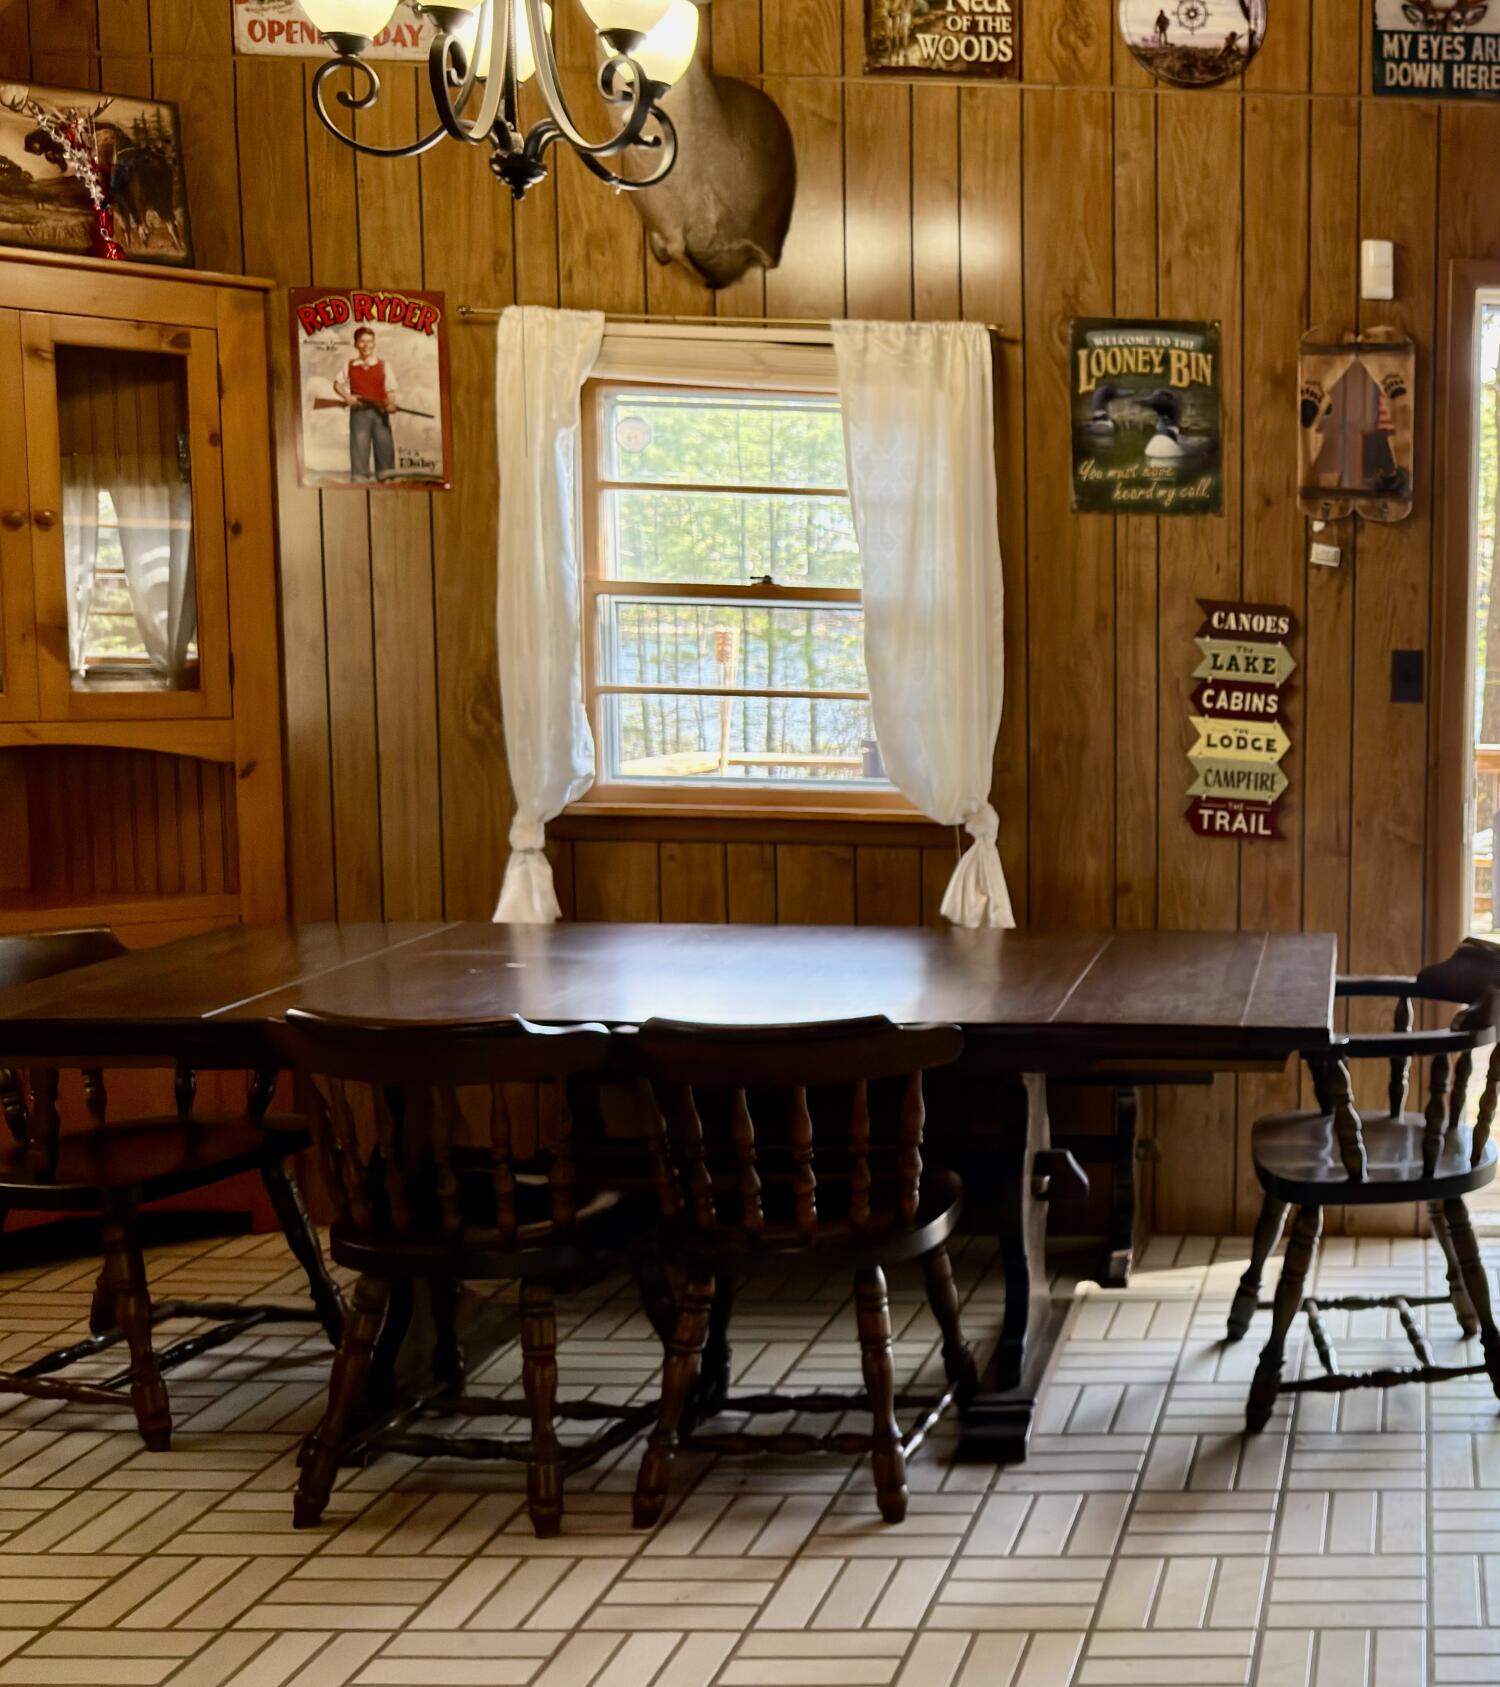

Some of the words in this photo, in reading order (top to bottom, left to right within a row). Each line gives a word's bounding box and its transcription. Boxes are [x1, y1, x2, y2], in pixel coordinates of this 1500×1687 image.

[247, 18, 325, 45] OPEN
[946, 15, 971, 32] OF
[974, 15, 1012, 33] THE
[916, 33, 1013, 62] WOODS
[1383, 33, 1412, 59] MY
[1417, 34, 1466, 61] EYES
[1385, 61, 1444, 88] DOWN
[297, 298, 350, 336] RED
[352, 292, 438, 336] RYDER
[1078, 346, 1165, 395] LOONEY
[1168, 348, 1213, 388] BIN
[1212, 610, 1290, 635] CANOES
[1211, 653, 1276, 675] LAKE
[1202, 688, 1279, 714] CABINS
[1206, 733, 1277, 753] LODGE
[1203, 768, 1277, 793] CAMPFIRE
[1198, 809, 1272, 835] TRAIL
